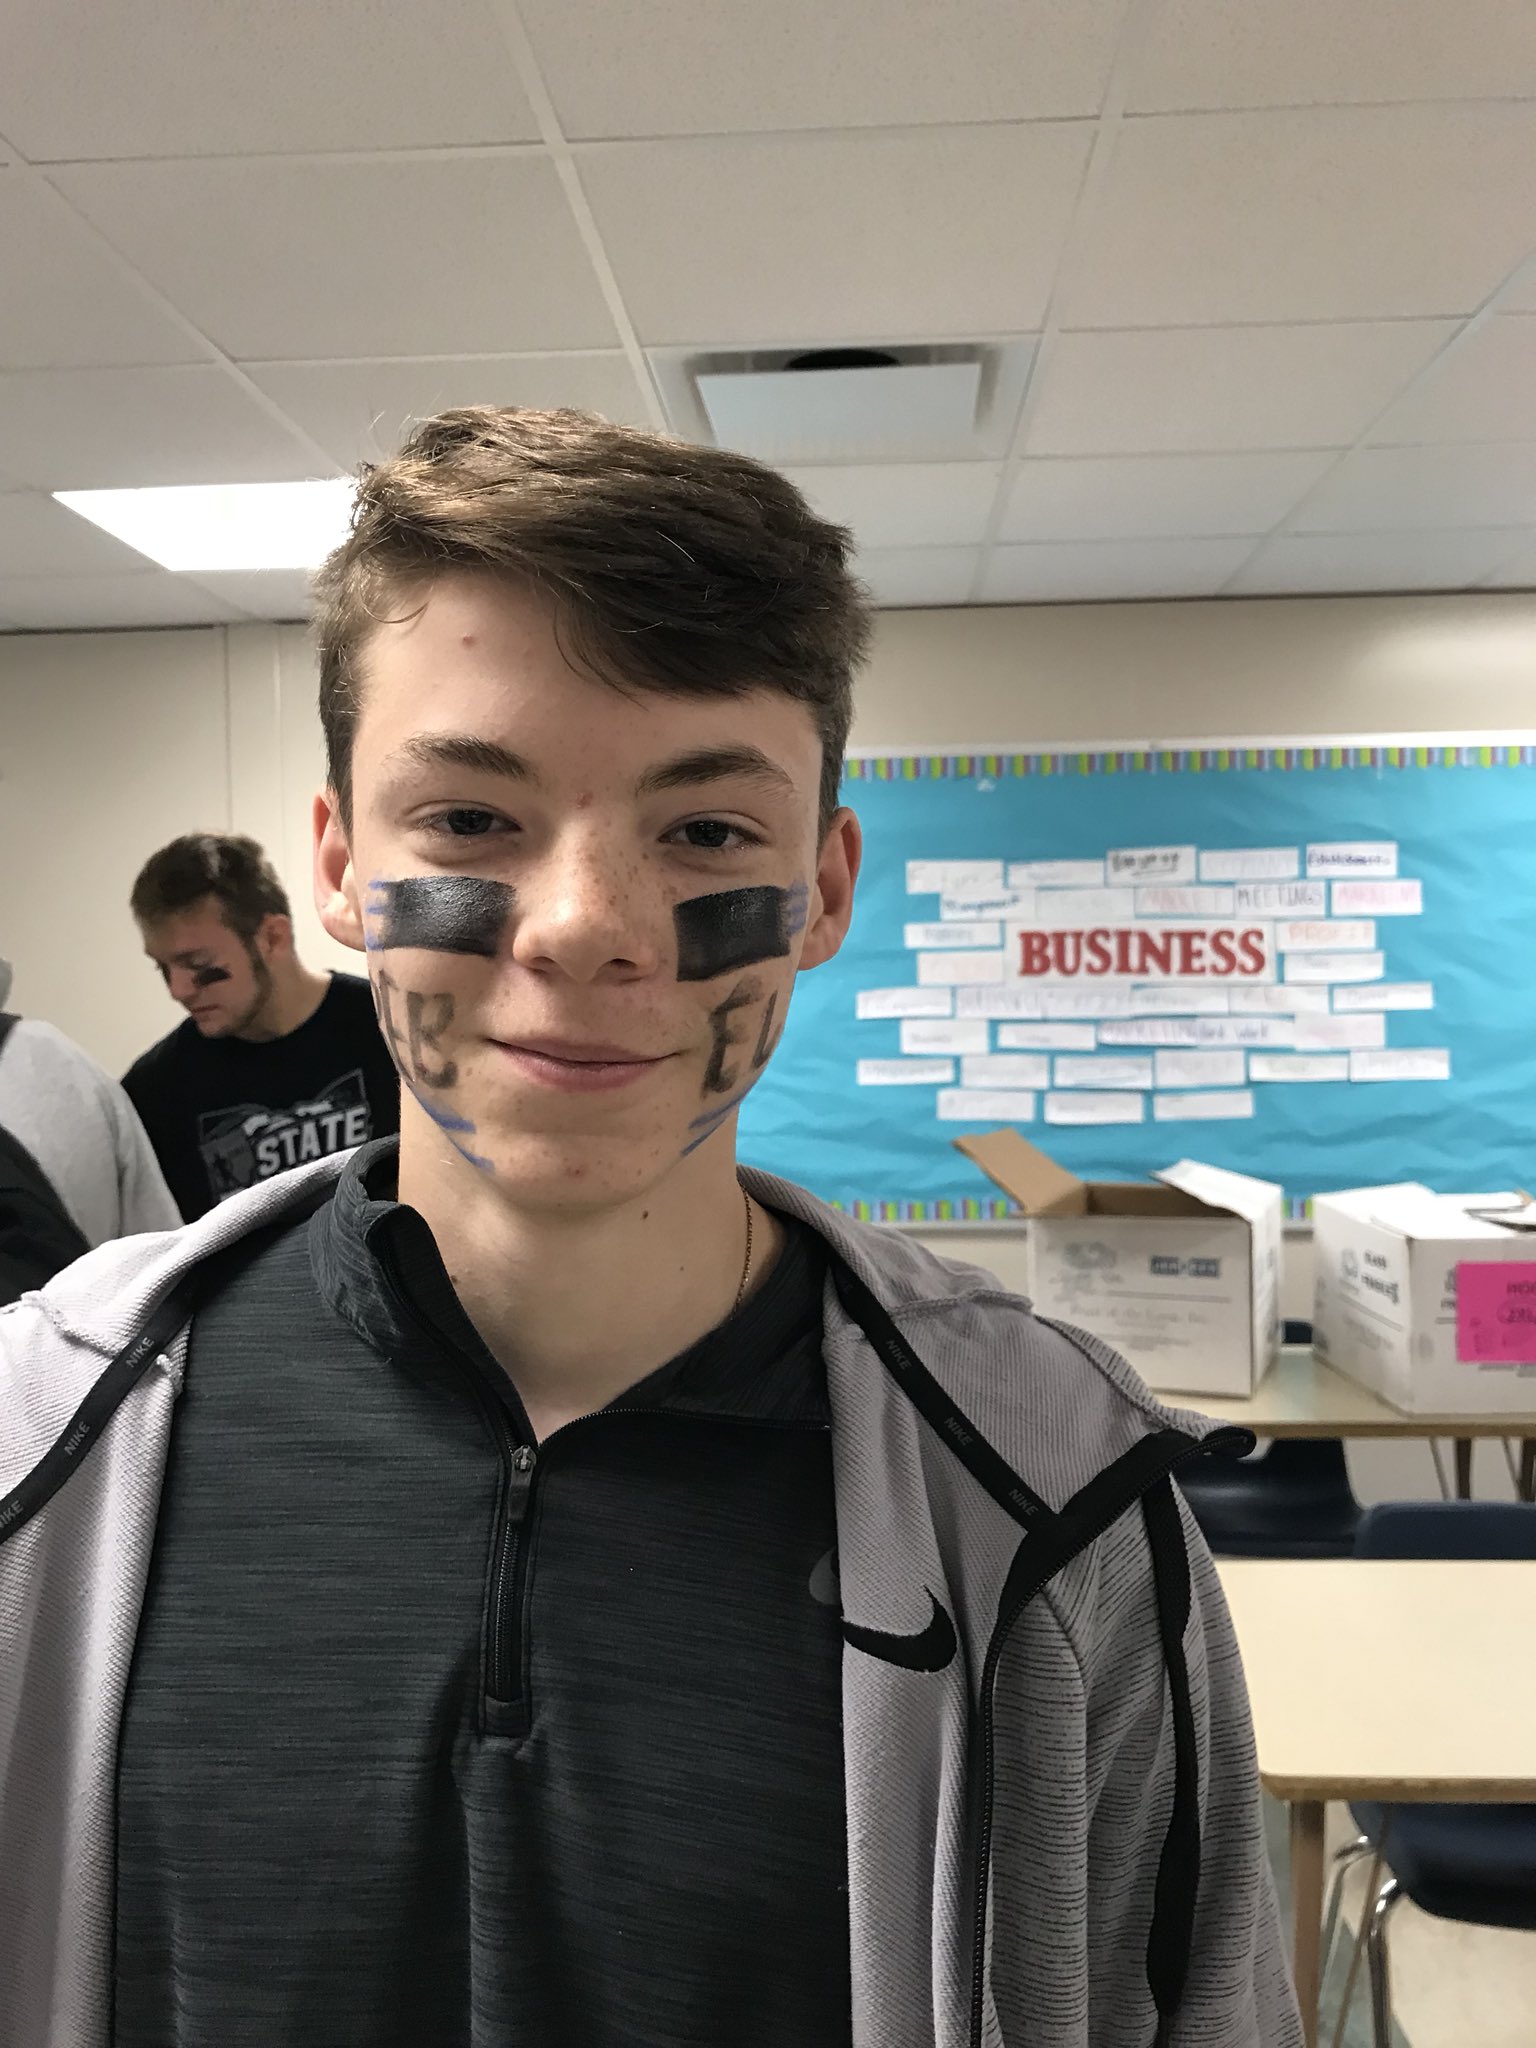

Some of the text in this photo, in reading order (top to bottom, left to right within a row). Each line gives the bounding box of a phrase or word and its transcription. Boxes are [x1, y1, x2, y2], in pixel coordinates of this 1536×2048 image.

[1237, 885, 1323, 906] MEETINGS
[1019, 927, 1267, 977] BUSINESS
[256, 1106, 369, 1177] STATE
[126, 1336, 155, 1368] NIKE
[885, 1340, 912, 1370] NIKE
[64, 1420, 91, 1455] NIKE
[943, 1416, 973, 1447] NIKE
[1008, 1488, 1040, 1517] NIKE
